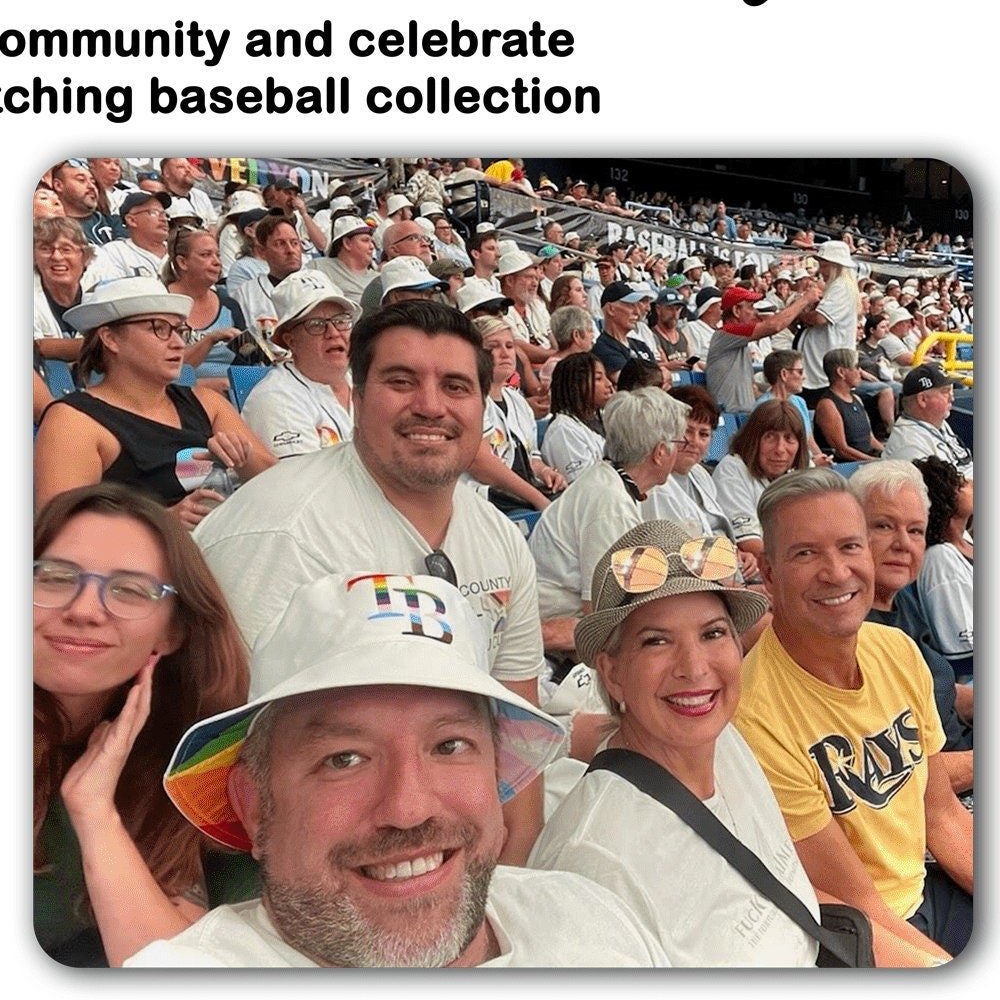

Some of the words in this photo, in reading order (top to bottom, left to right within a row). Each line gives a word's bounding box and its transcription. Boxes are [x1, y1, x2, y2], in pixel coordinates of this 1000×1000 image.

[610, 167, 629, 182] 132
[459, 576, 512, 597] COUNTY
[346, 573, 453, 645] TB
[808, 707, 923, 815] RAYS
[735, 895, 767, 938] FUCK
